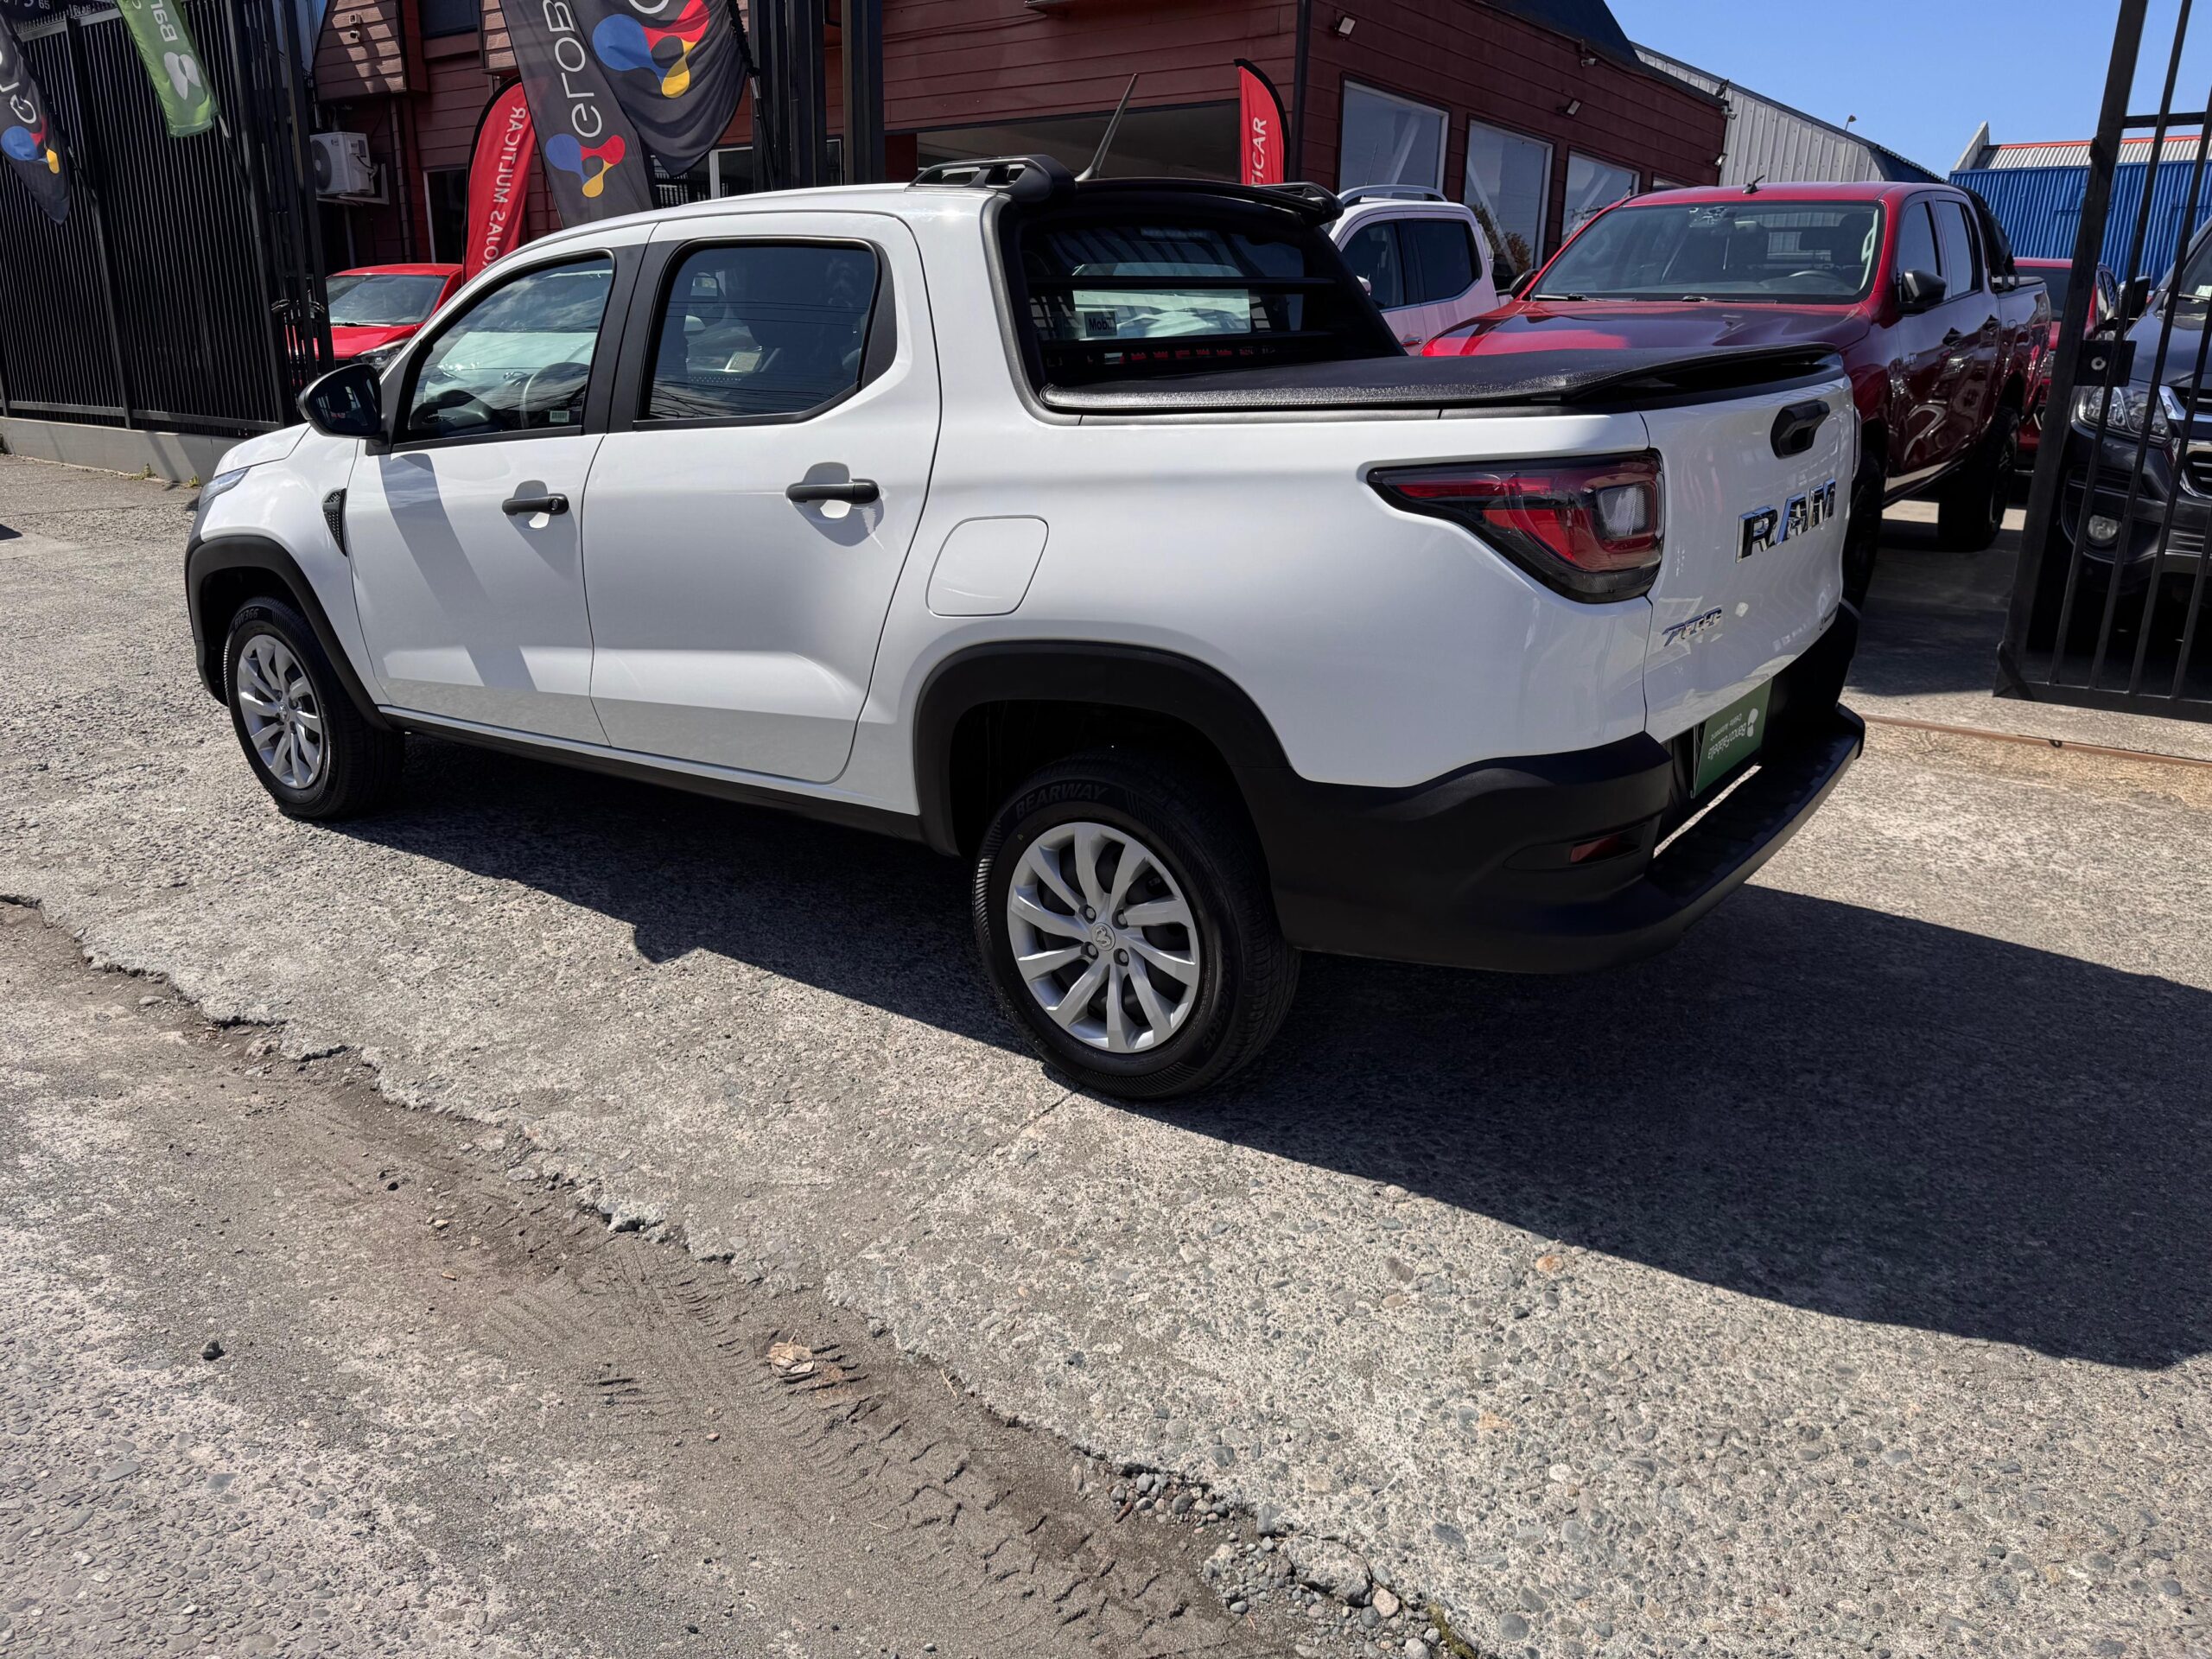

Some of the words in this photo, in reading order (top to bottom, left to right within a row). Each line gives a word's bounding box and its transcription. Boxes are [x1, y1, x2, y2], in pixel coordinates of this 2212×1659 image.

[1735, 477, 1835, 563] RAM
[1662, 607, 1722, 646] 700
[1015, 782, 1109, 821] BEARWAY
